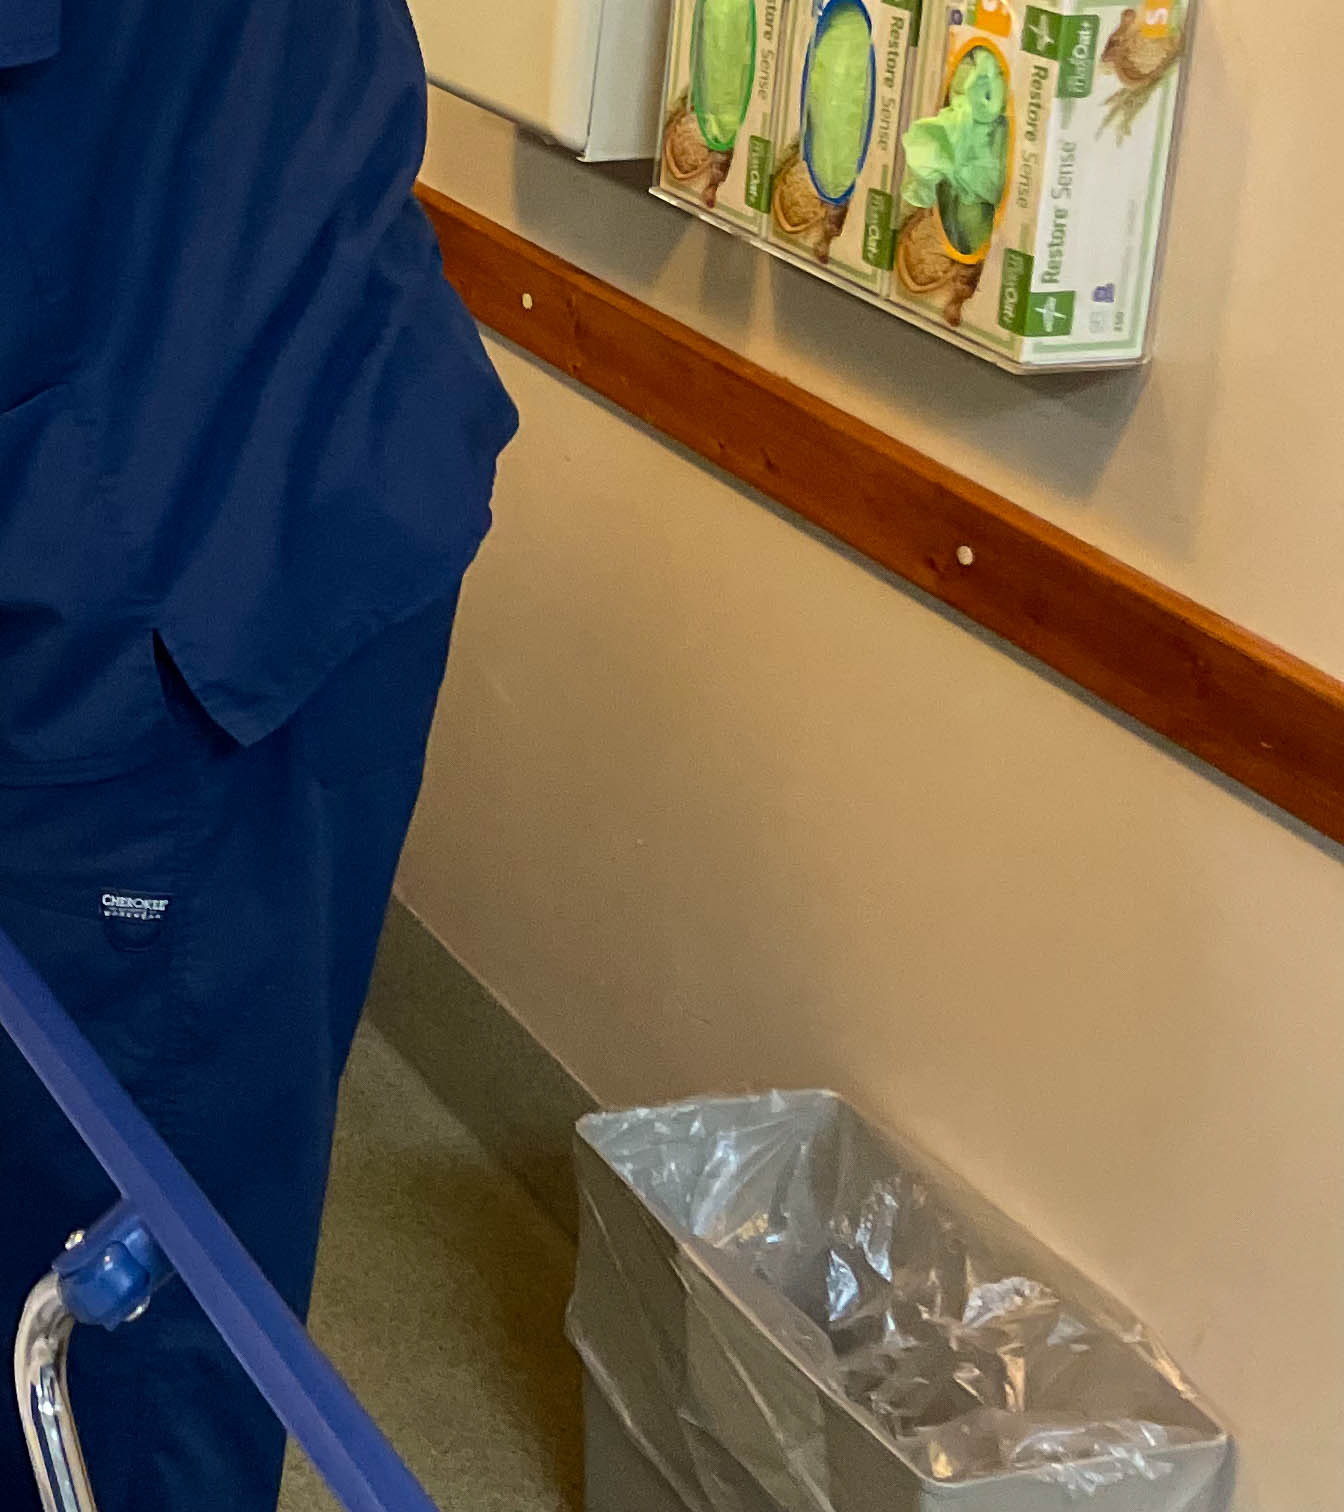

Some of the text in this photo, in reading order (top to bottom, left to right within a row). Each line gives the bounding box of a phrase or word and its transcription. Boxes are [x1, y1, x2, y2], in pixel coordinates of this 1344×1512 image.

[1145, 6, 1168, 26] S
[757, 47, 775, 101] Sense
[879, 15, 905, 152] Restore Sense
[1015, 64, 1050, 209] Restore Sense
[1041, 141, 1077, 285] Restore Sense
[102, 893, 169, 912] CHEROKEE
